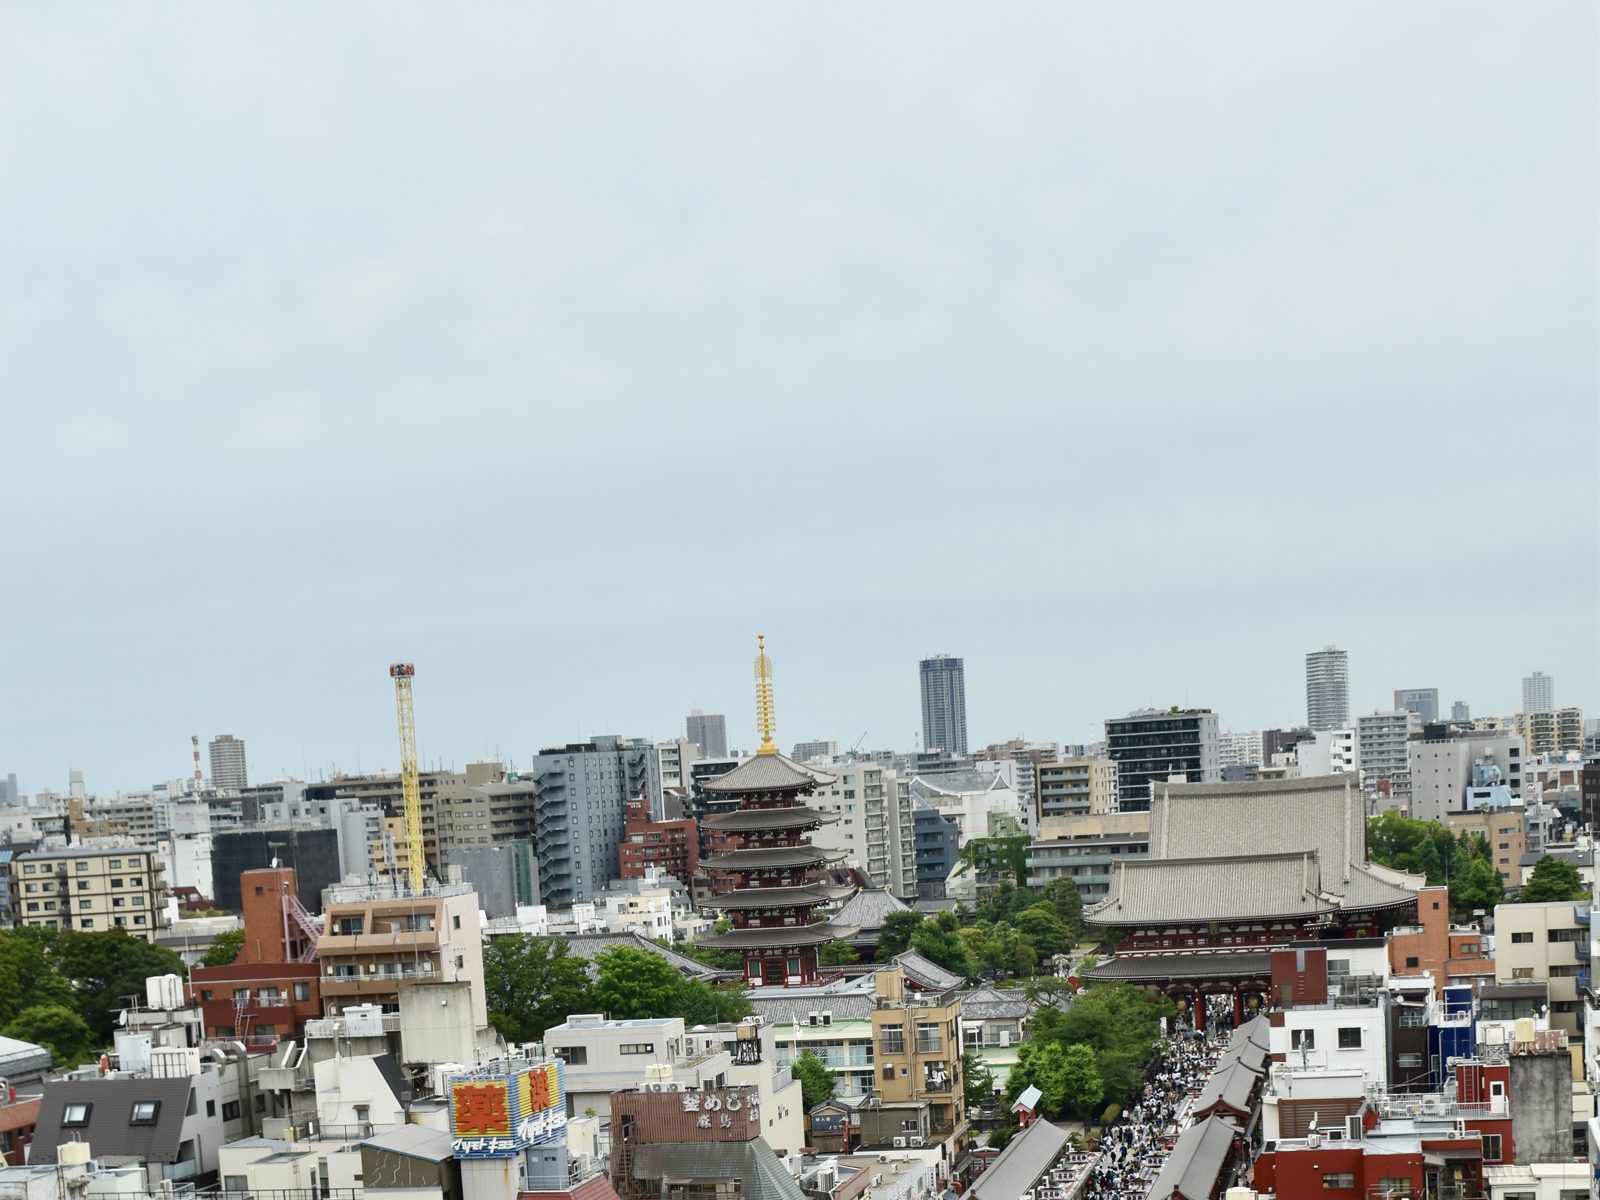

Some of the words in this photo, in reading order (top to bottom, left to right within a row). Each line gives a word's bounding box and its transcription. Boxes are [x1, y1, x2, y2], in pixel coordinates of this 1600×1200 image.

[454, 1084, 508, 1134] 薬
[529, 1067, 551, 1111] 薬
[451, 1137, 516, 1154] マツモトキヨシ
